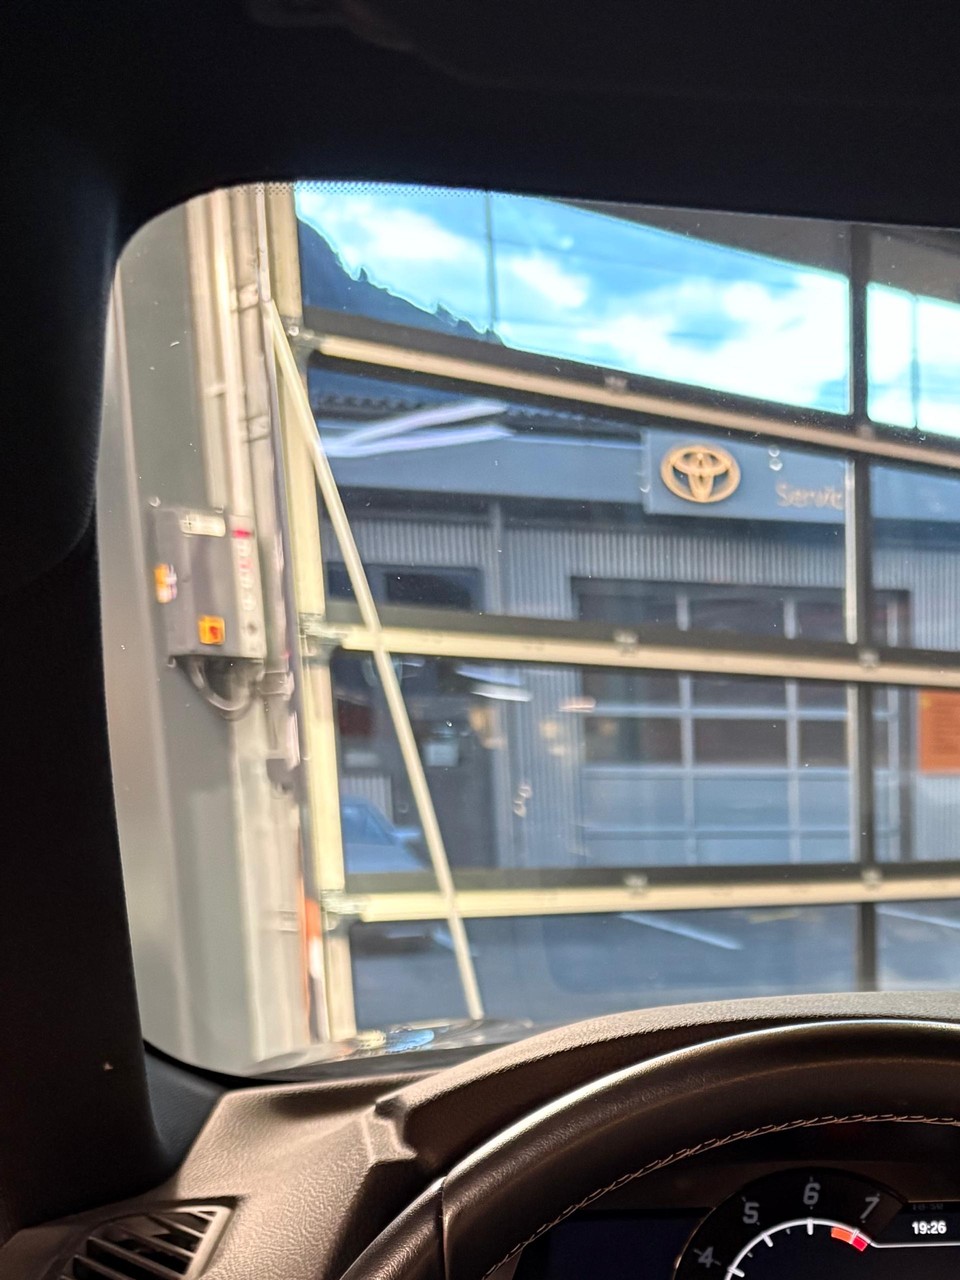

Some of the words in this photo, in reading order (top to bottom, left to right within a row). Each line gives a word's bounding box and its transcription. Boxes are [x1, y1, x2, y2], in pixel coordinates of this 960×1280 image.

[803, 1182, 821, 1205] 6
[742, 1201, 760, 1224] 5
[860, 1196, 880, 1220] 7
[912, 1220, 947, 1235] 19:26
[697, 1246, 715, 1268] 4
